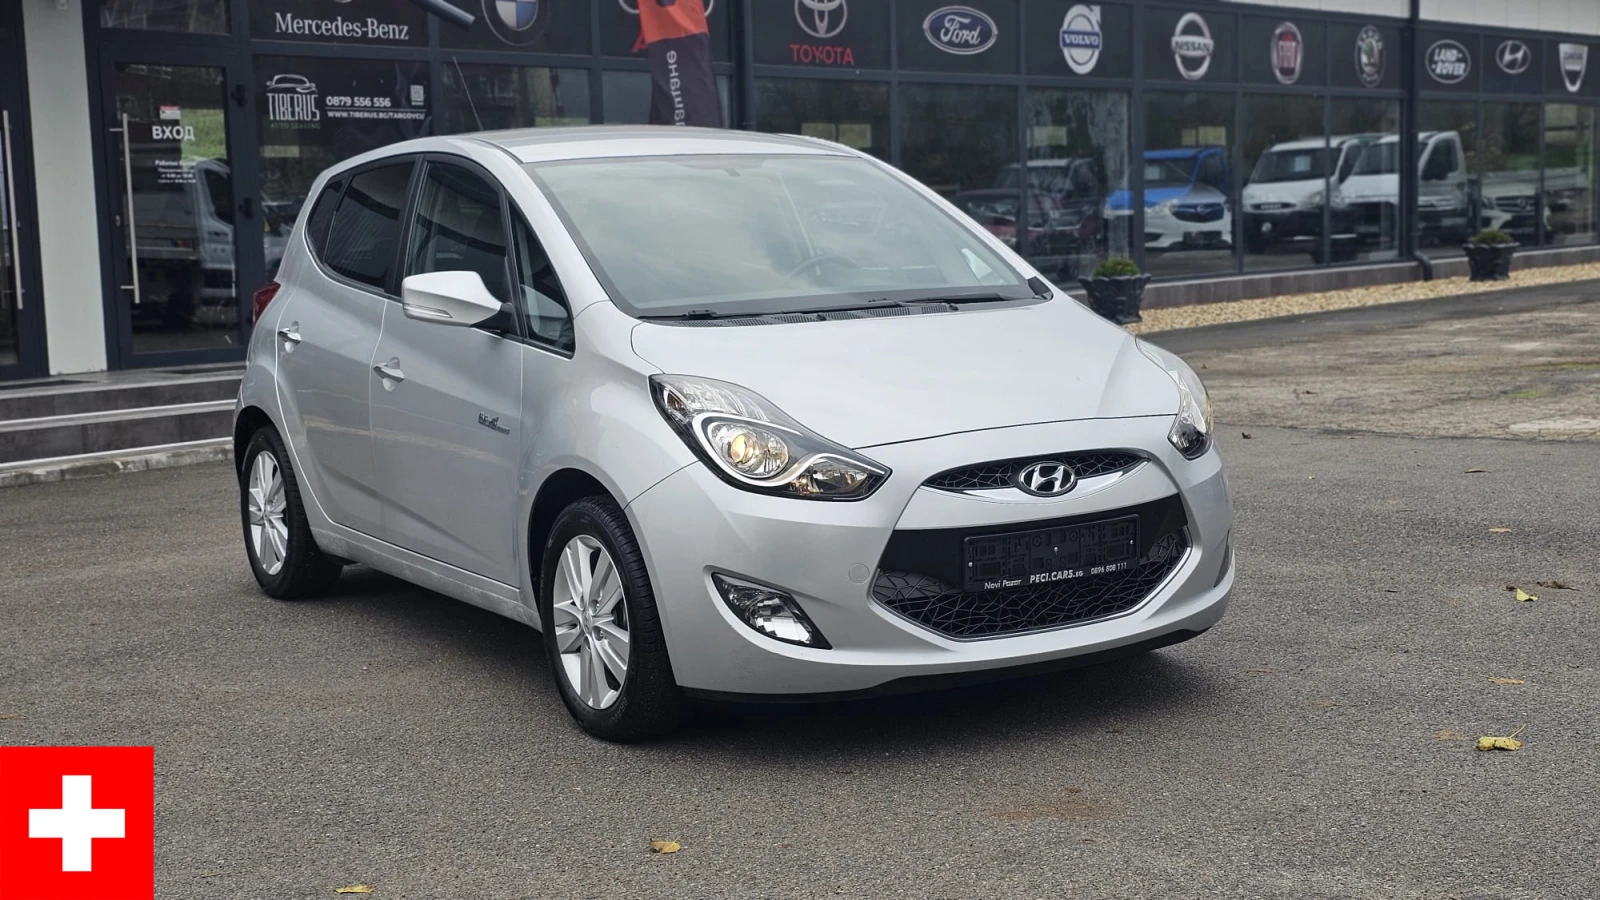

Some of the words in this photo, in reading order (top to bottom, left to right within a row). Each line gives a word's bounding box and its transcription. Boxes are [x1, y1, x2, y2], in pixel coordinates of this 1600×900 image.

[275, 12, 409, 40] Mercedes-Benz
[940, 15, 981, 45] Ford
[1063, 33, 1099, 46] VOLVO
[1174, 40, 1210, 52] NISSAN
[789, 43, 855, 65] TOYOTA
[266, 93, 320, 121] TIBERUS
[326, 96, 351, 106] 0879
[353, 97, 371, 107] 556
[373, 97, 391, 107] 556
[152, 125, 195, 141] ВХОД
[984, 580, 1001, 590] Novi
[1002, 579, 1022, 588] Pazar
[1117, 561, 1127, 570] 111
